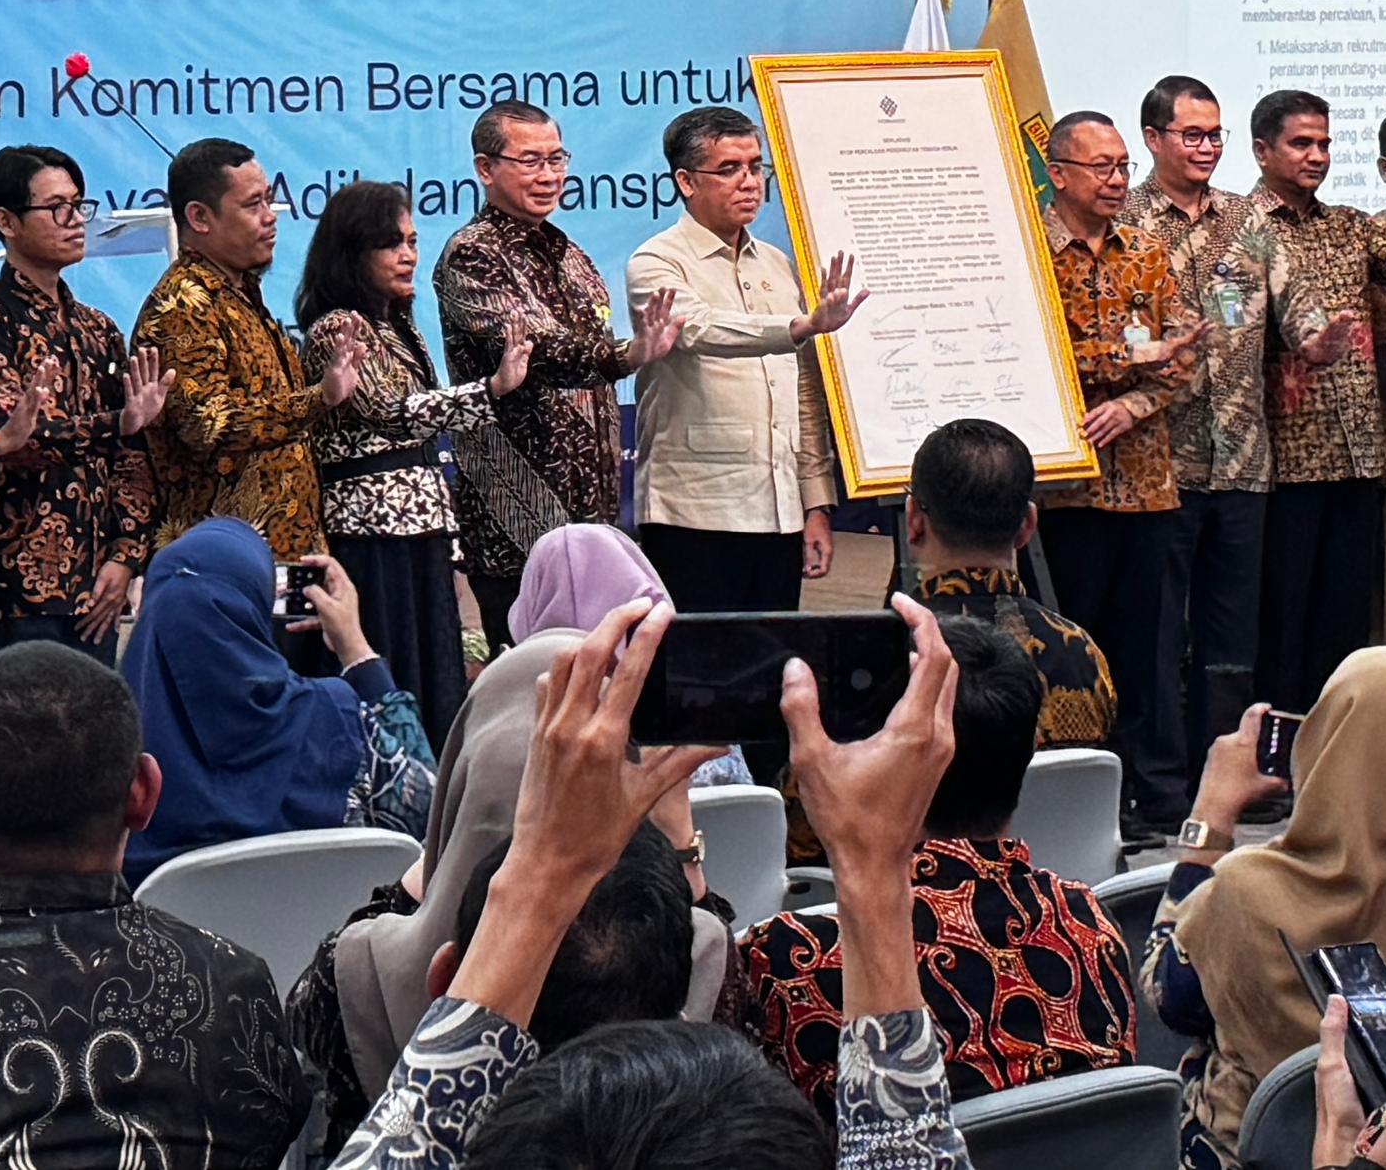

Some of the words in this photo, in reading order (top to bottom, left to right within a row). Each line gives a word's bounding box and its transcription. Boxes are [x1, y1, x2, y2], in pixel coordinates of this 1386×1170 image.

[1269, 38, 1343, 54] Melaksanakan
[1269, 61, 1319, 79] peraturan
[52, 63, 344, 117] Komitmen
[367, 61, 599, 111] Bersama
[1333, 108, 1365, 120] secara
